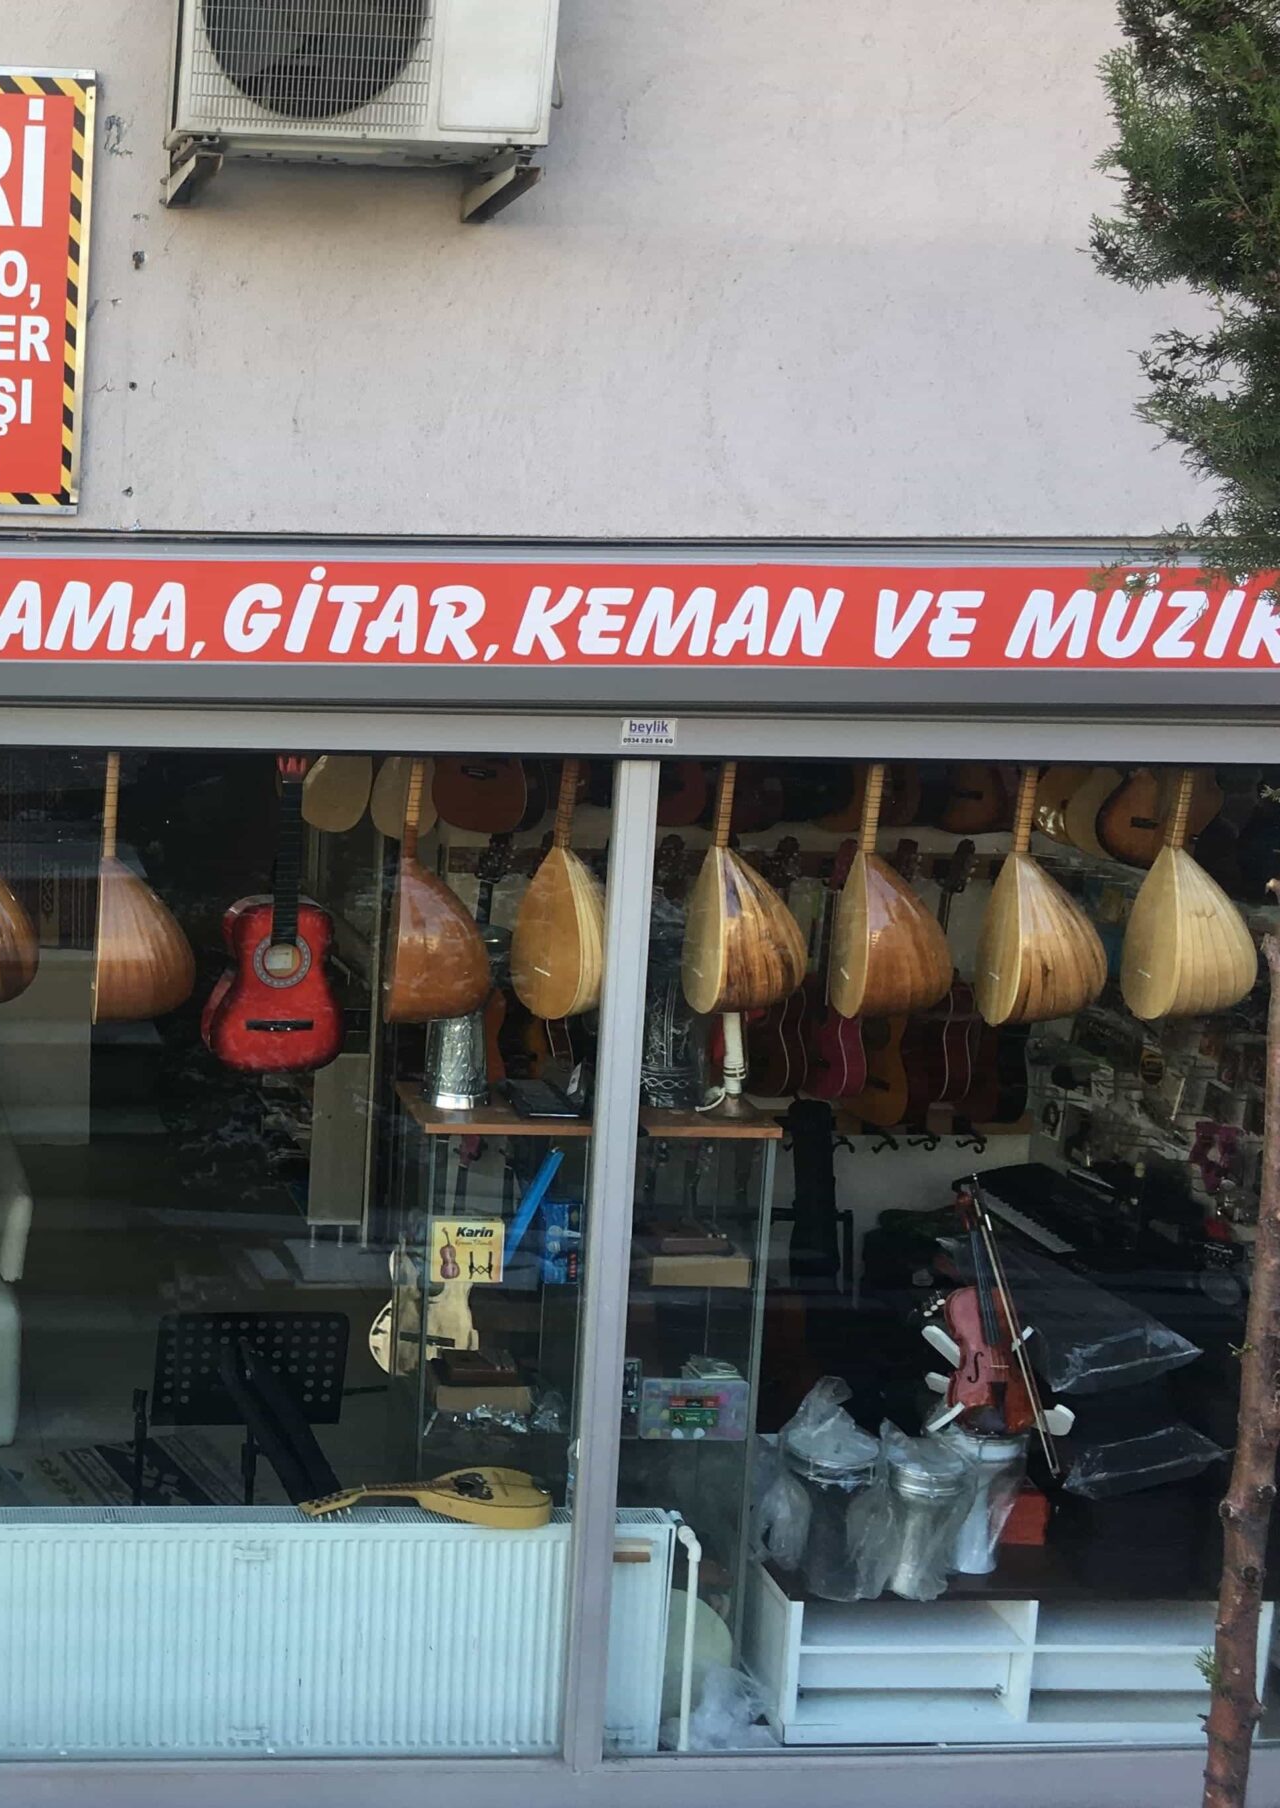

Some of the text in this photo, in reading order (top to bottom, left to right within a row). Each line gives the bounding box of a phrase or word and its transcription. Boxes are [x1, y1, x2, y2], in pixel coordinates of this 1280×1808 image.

[224, 566, 500, 661] GİTAR,
[513, 586, 844, 660] KEMAN
[875, 589, 985, 658] VE
[629, 720, 668, 735] beylik
[456, 1227, 493, 1237] Karin
